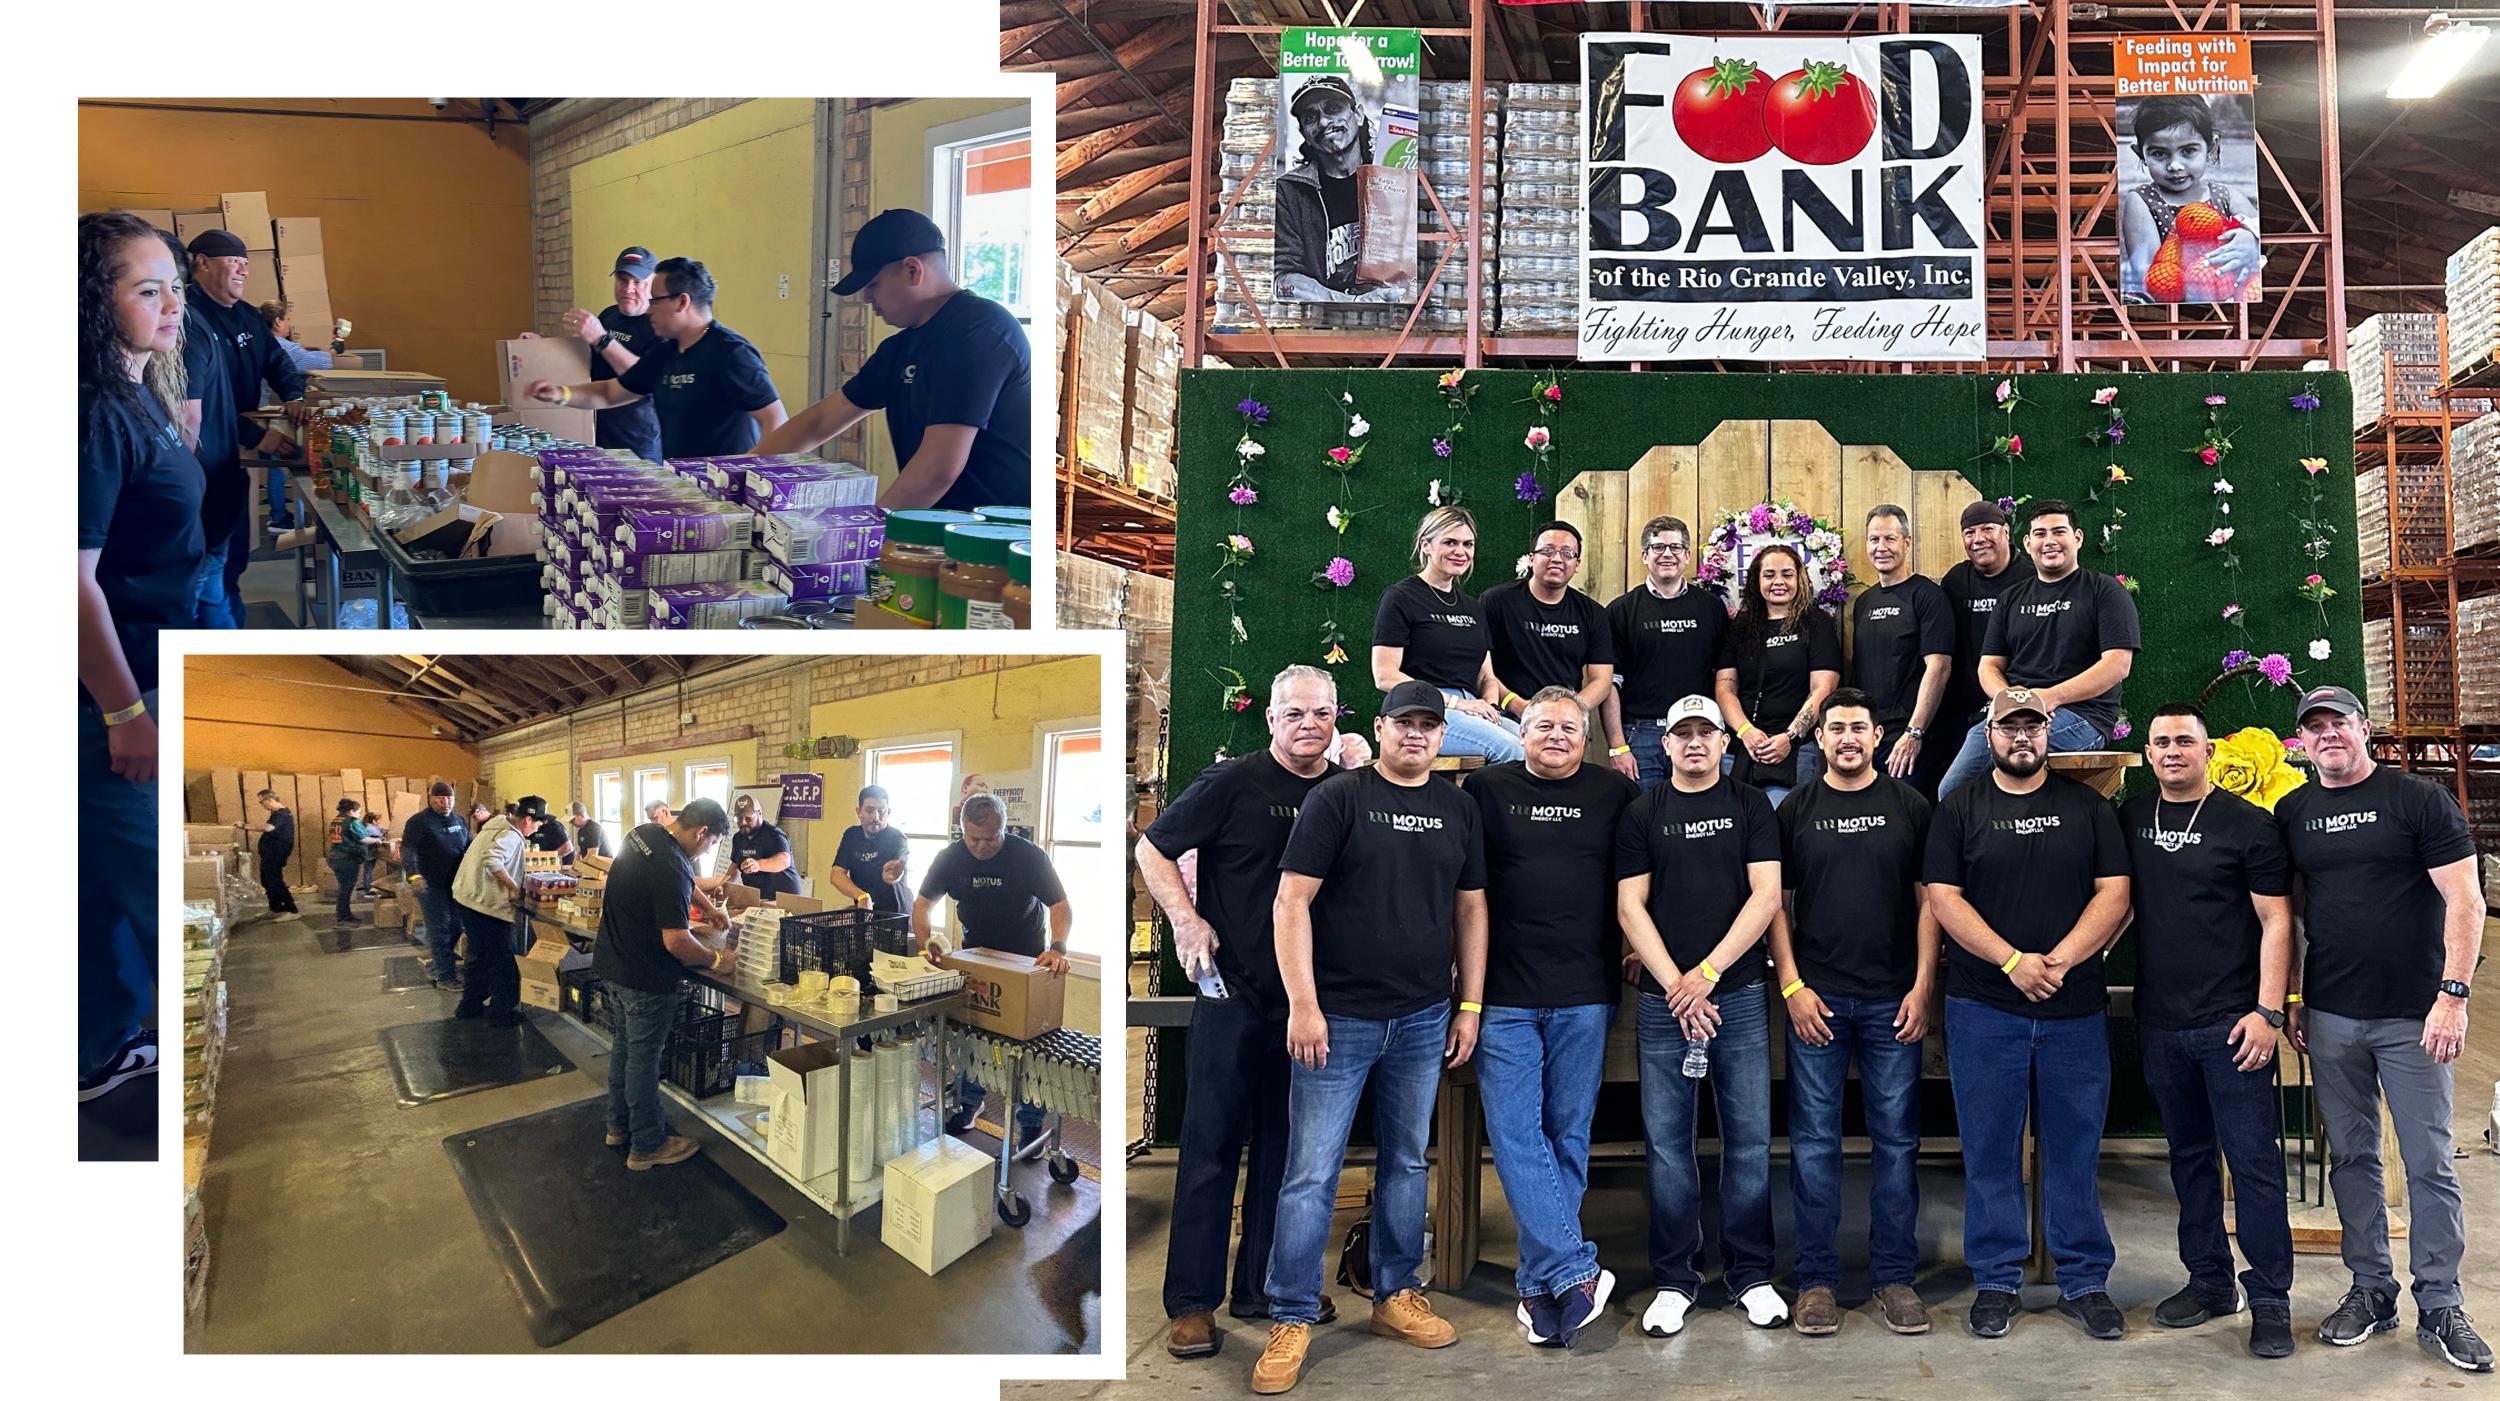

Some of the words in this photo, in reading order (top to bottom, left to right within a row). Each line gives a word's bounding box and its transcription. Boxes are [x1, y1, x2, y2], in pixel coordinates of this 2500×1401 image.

[1378, 36, 1388, 48] a
[2126, 38, 2192, 57] Feeding
[2198, 37, 2237, 54] with
[1283, 51, 1330, 68] Better
[2138, 57, 2197, 77] Impact
[2201, 56, 2228, 73] for
[2118, 77, 2171, 94] Better
[2174, 75, 2249, 92] Nutrition
[1589, 165, 1979, 253] BANK
[1598, 266, 1626, 288] of
[1631, 266, 1669, 288] the
[1678, 266, 1722, 288] Rio
[1730, 266, 1826, 288] Grande
[1835, 264, 1915, 290] Valley,
[1924, 263, 1971, 286] Inc.
[1584, 307, 1689, 353] Fighting
[1695, 307, 1796, 353] Hunger,
[1813, 307, 1909, 353] Feeding
[1910, 304, 1981, 347] Hope
[343, 571, 377, 582] BAN
[1871, 606, 1901, 616] MOTUS
[1540, 623, 1580, 634] MOTUS
[1660, 619, 1698, 628] MOTUS
[1531, 805, 1582, 819] MOTUS
[1392, 813, 1443, 829] MOTUS
[1684, 817, 1734, 834] MOTUS
[1837, 815, 1886, 829] MOTUS
[2014, 815, 2061, 830] MOTUS
[2325, 811, 2378, 829] MOTUS
[2155, 830, 2203, 845] MOTUS
[972, 876, 1003, 887] MOTUS
